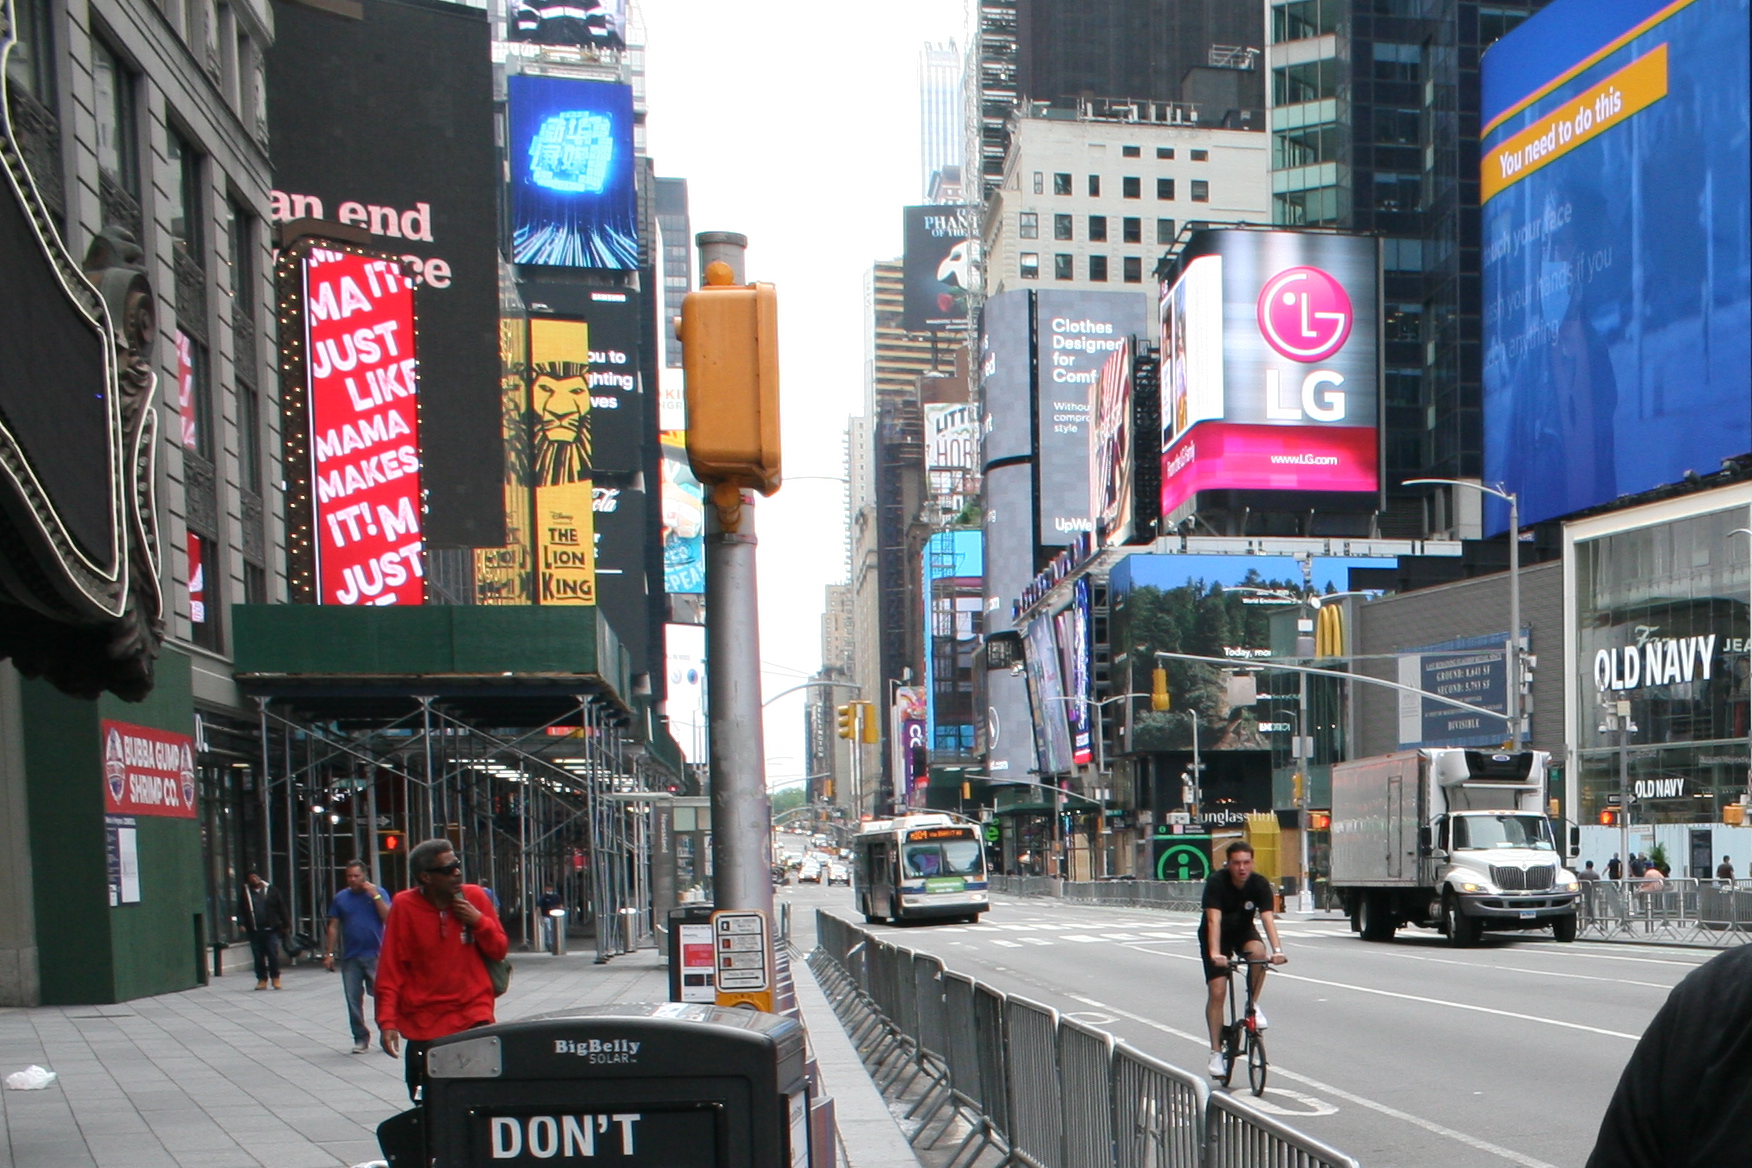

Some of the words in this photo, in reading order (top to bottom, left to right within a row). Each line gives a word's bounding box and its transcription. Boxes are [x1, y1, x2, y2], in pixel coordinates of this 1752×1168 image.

[1500, 154, 1521, 178] You
[1525, 124, 1556, 163] need
[1559, 121, 1572, 144] to
[1575, 106, 1592, 135] do
[1595, 86, 1621, 122] this
[338, 202, 434, 242] end
[924, 215, 978, 230] PHANT
[1052, 318, 1113, 335] Clothes
[313, 320, 398, 379] JUST
[587, 352, 606, 363] ou
[609, 350, 626, 364] to
[1053, 353, 1075, 367] for
[1053, 367, 1099, 383] Comf
[1054, 401, 1090, 412] Withou
[1266, 369, 1345, 422] LG
[936, 406, 969, 435] LITT
[1054, 424, 1078, 434] style
[317, 409, 410, 462] MAMA
[1270, 453, 1338, 466] www.LG.com
[318, 445, 420, 503] MAKES
[326, 502, 378, 548] IT!
[551, 511, 574, 522] Disney
[1055, 517, 1093, 532] UpWe
[549, 527, 579, 542] THE
[544, 544, 585, 570] LION
[336, 541, 424, 605] JUST
[541, 571, 593, 600] KING
[1223, 647, 1254, 659] Today,
[1723, 638, 1752, 652] JEA
[1595, 646, 1640, 692] OLD
[1646, 633, 1716, 687] NAVY
[123, 735, 155, 769] BUBBA
[156, 742, 180, 773] GUMP
[129, 773, 163, 805] SHRIMP
[1635, 779, 1656, 799] OLD
[1656, 778, 1685, 798] NAVY
[554, 1038, 641, 1056] BigBelly
[490, 1113, 641, 1160] DON'T
